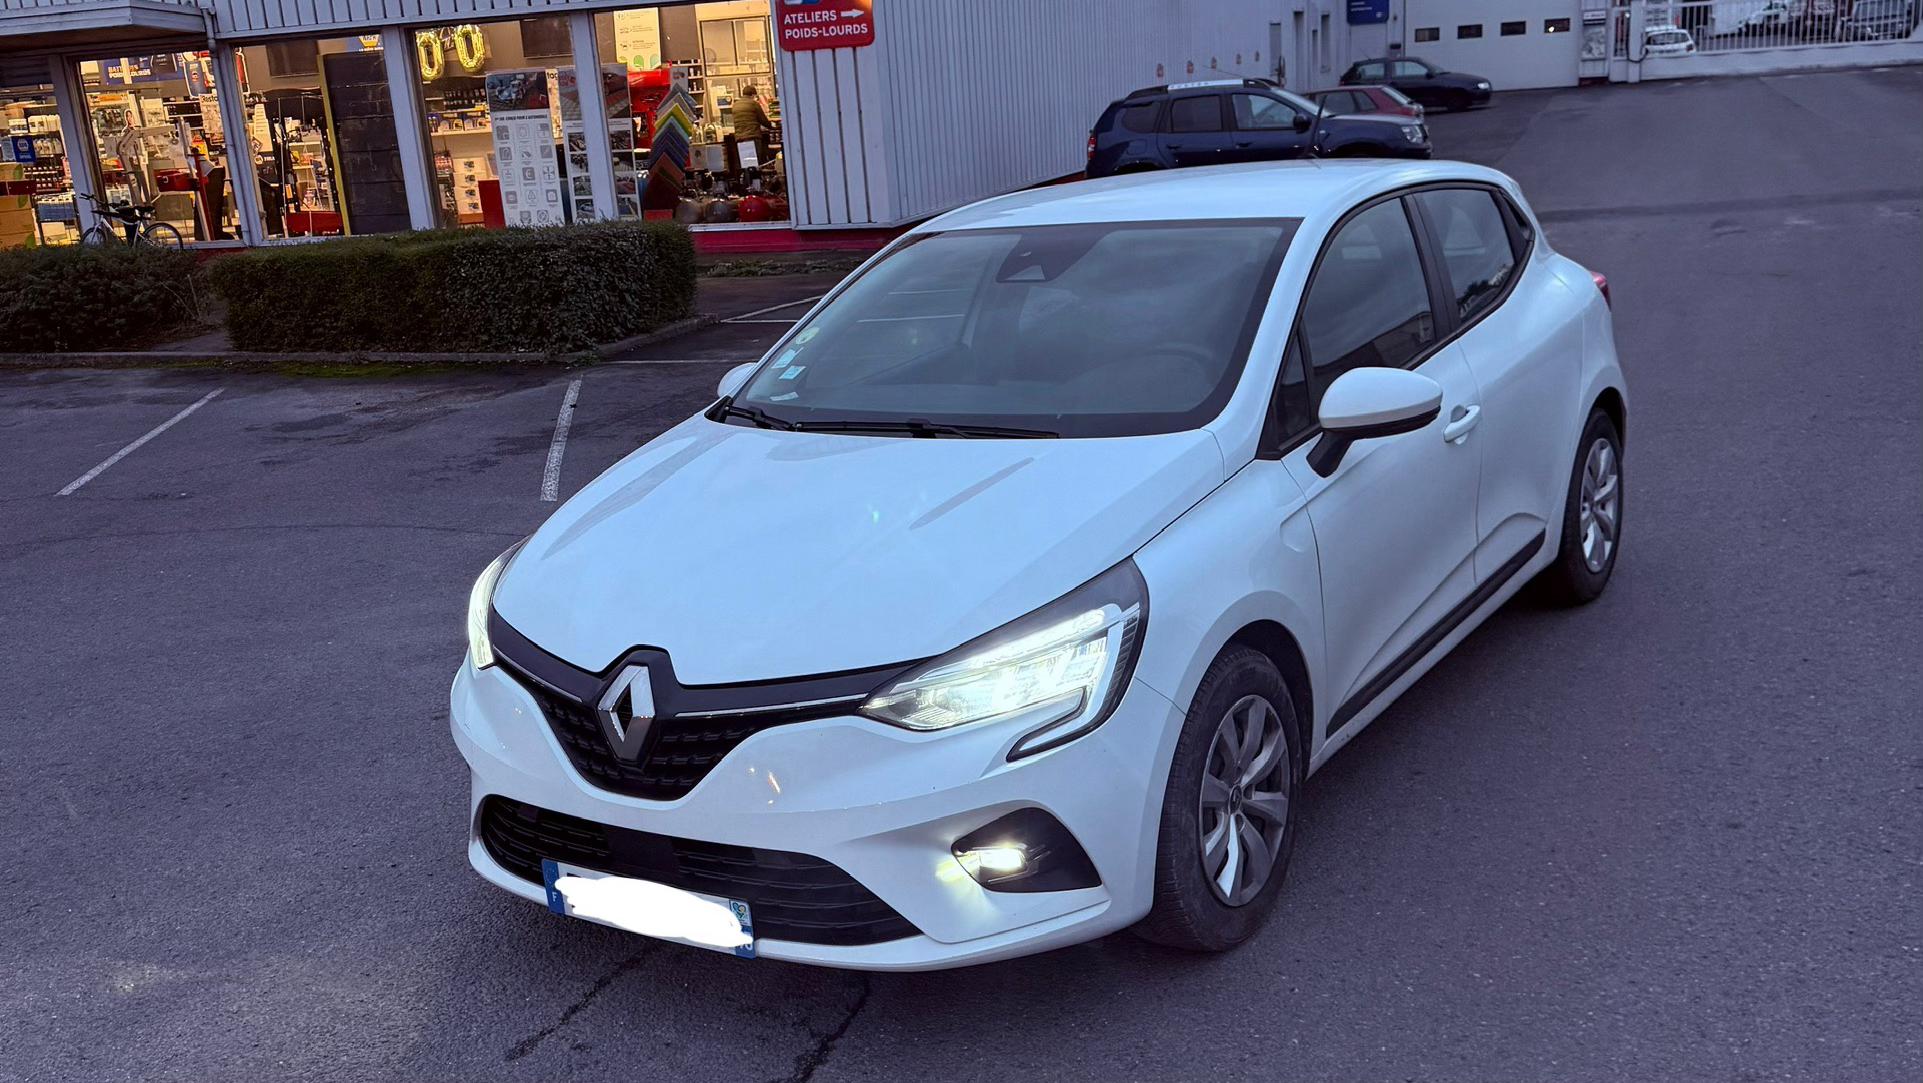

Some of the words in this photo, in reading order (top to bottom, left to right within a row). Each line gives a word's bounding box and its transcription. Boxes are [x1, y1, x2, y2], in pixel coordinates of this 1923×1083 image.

[784, 10, 837, 25] ATELIERS
[785, 23, 869, 39] POIDS-LOURDS
[551, 891, 558, 902] F
